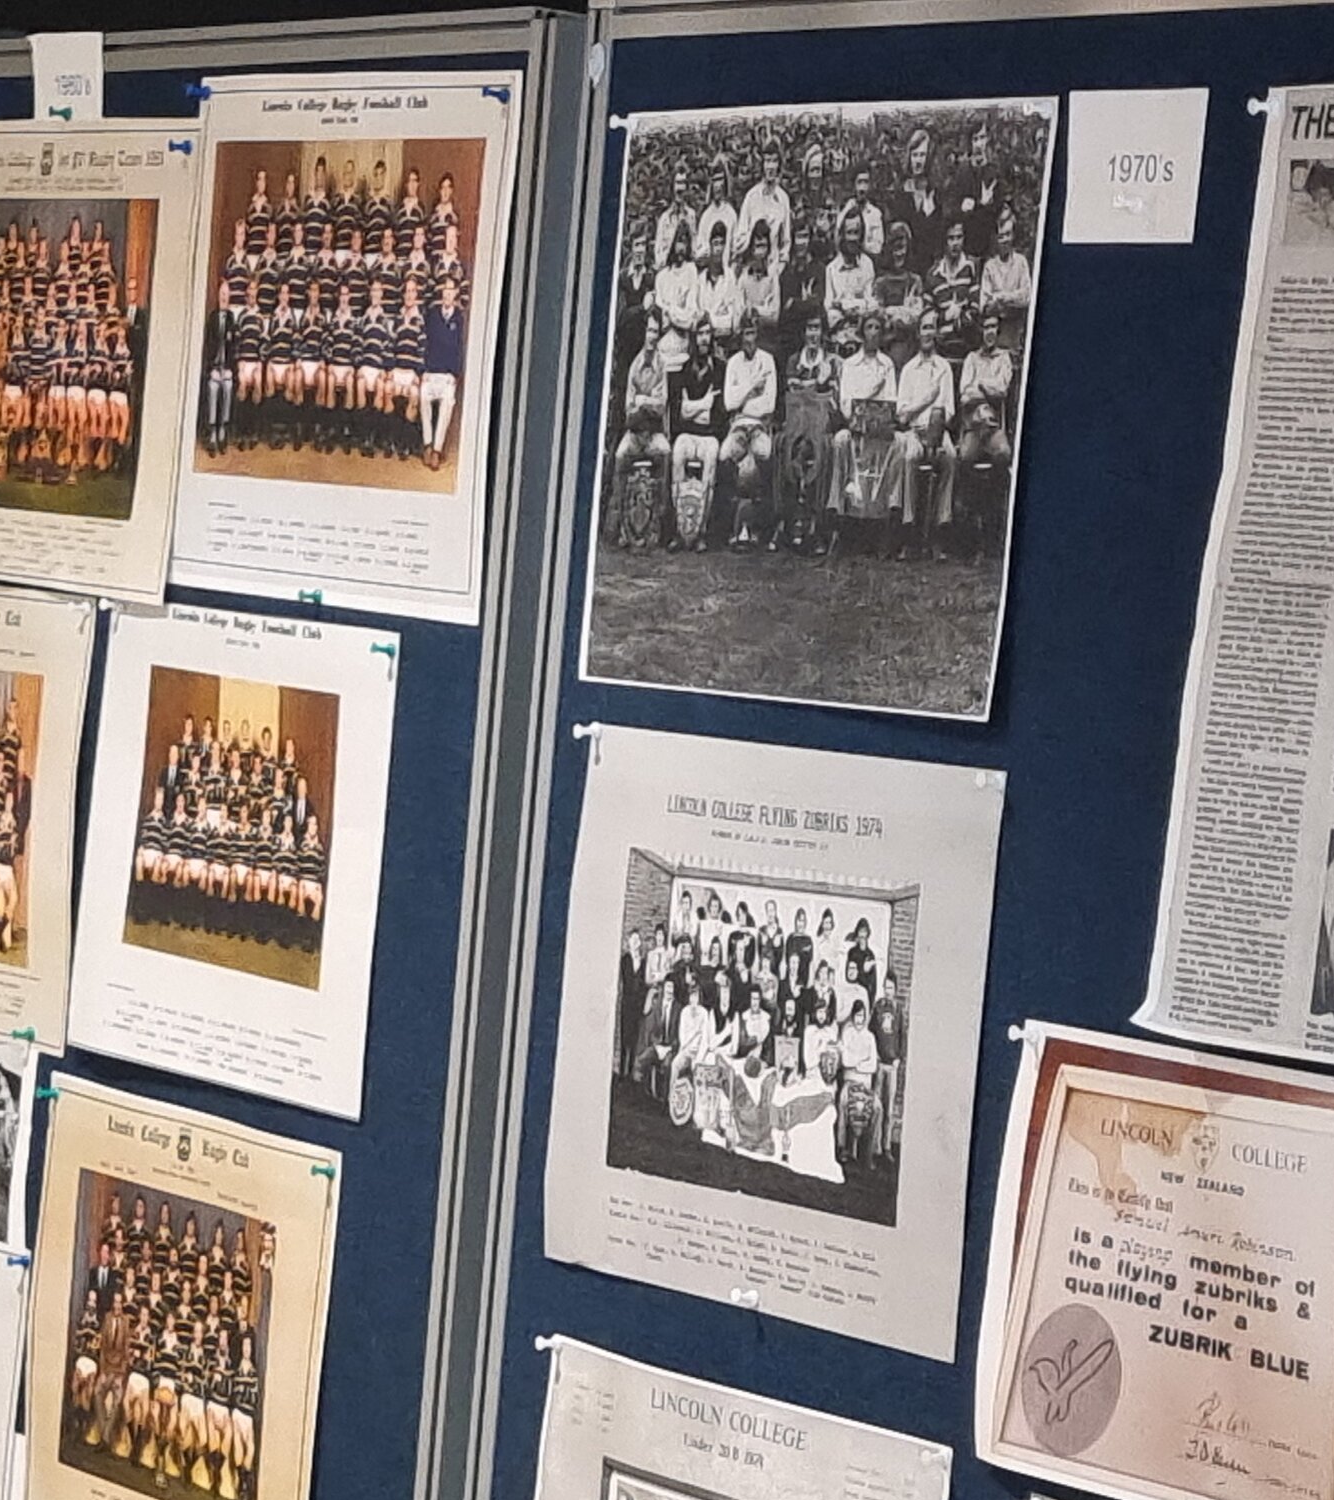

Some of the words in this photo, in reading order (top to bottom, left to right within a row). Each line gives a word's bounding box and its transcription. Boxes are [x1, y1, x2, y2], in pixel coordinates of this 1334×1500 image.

[1107, 153, 1174, 183] 1970's
[711, 800, 754, 823] COLLEGE
[759, 804, 797, 828] FLYING
[803, 810, 849, 834] ZUBRIKS
[1101, 1118, 1174, 1148] LINCOLN
[1231, 1143, 1308, 1174] COLLEGE
[1161, 1170, 1185, 1184] NEW
[1195, 1177, 1245, 1197] ZEALAND
[1069, 1249, 1101, 1271] the
[1117, 1259, 1177, 1291] flying
[1194, 1280, 1279, 1313] zubriks
[1296, 1303, 1311, 1320] &
[1073, 1227, 1091, 1245] is
[1101, 1234, 1114, 1250] a
[1190, 1254, 1281, 1289] member
[1295, 1280, 1315, 1298] of
[1065, 1276, 1162, 1310] qualified
[1183, 1299, 1217, 1323] for
[1234, 1315, 1247, 1330] a
[1149, 1324, 1234, 1362] ZUBRIK
[1249, 1348, 1310, 1381] BLUE
[651, 1387, 724, 1425] LINCOLN
[729, 1411, 808, 1450] COLLEGE
